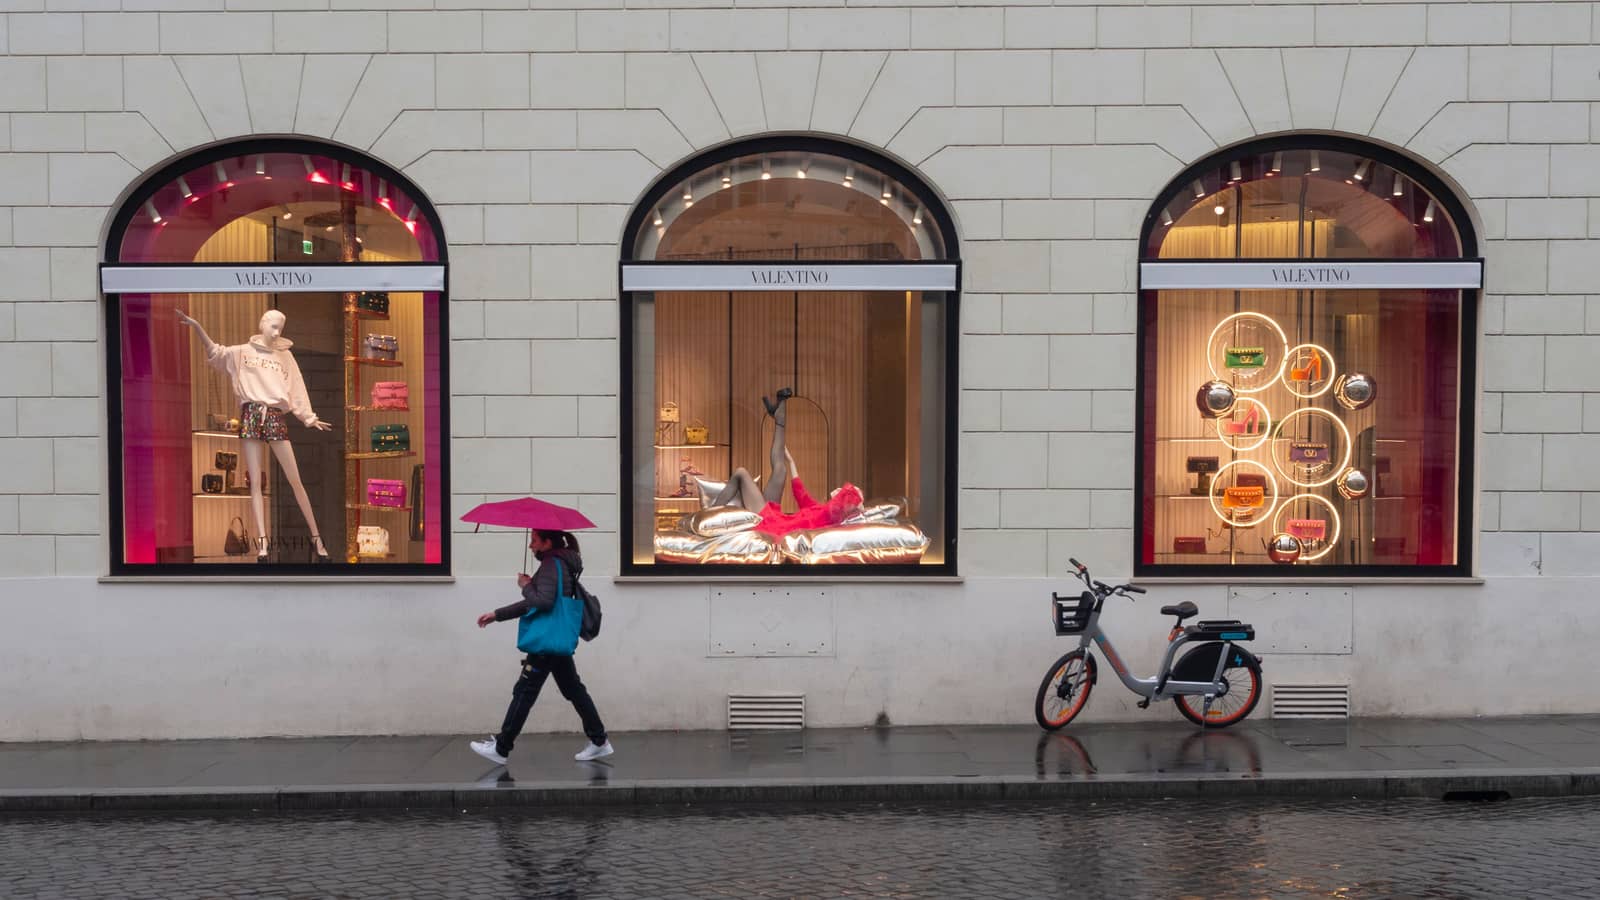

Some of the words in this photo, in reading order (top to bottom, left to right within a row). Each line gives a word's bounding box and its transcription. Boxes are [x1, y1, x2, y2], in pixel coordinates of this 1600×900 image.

[235, 271, 313, 285] VALENTINO
[751, 270, 829, 284] VALENTINO
[1272, 268, 1351, 282] VALENTINO
